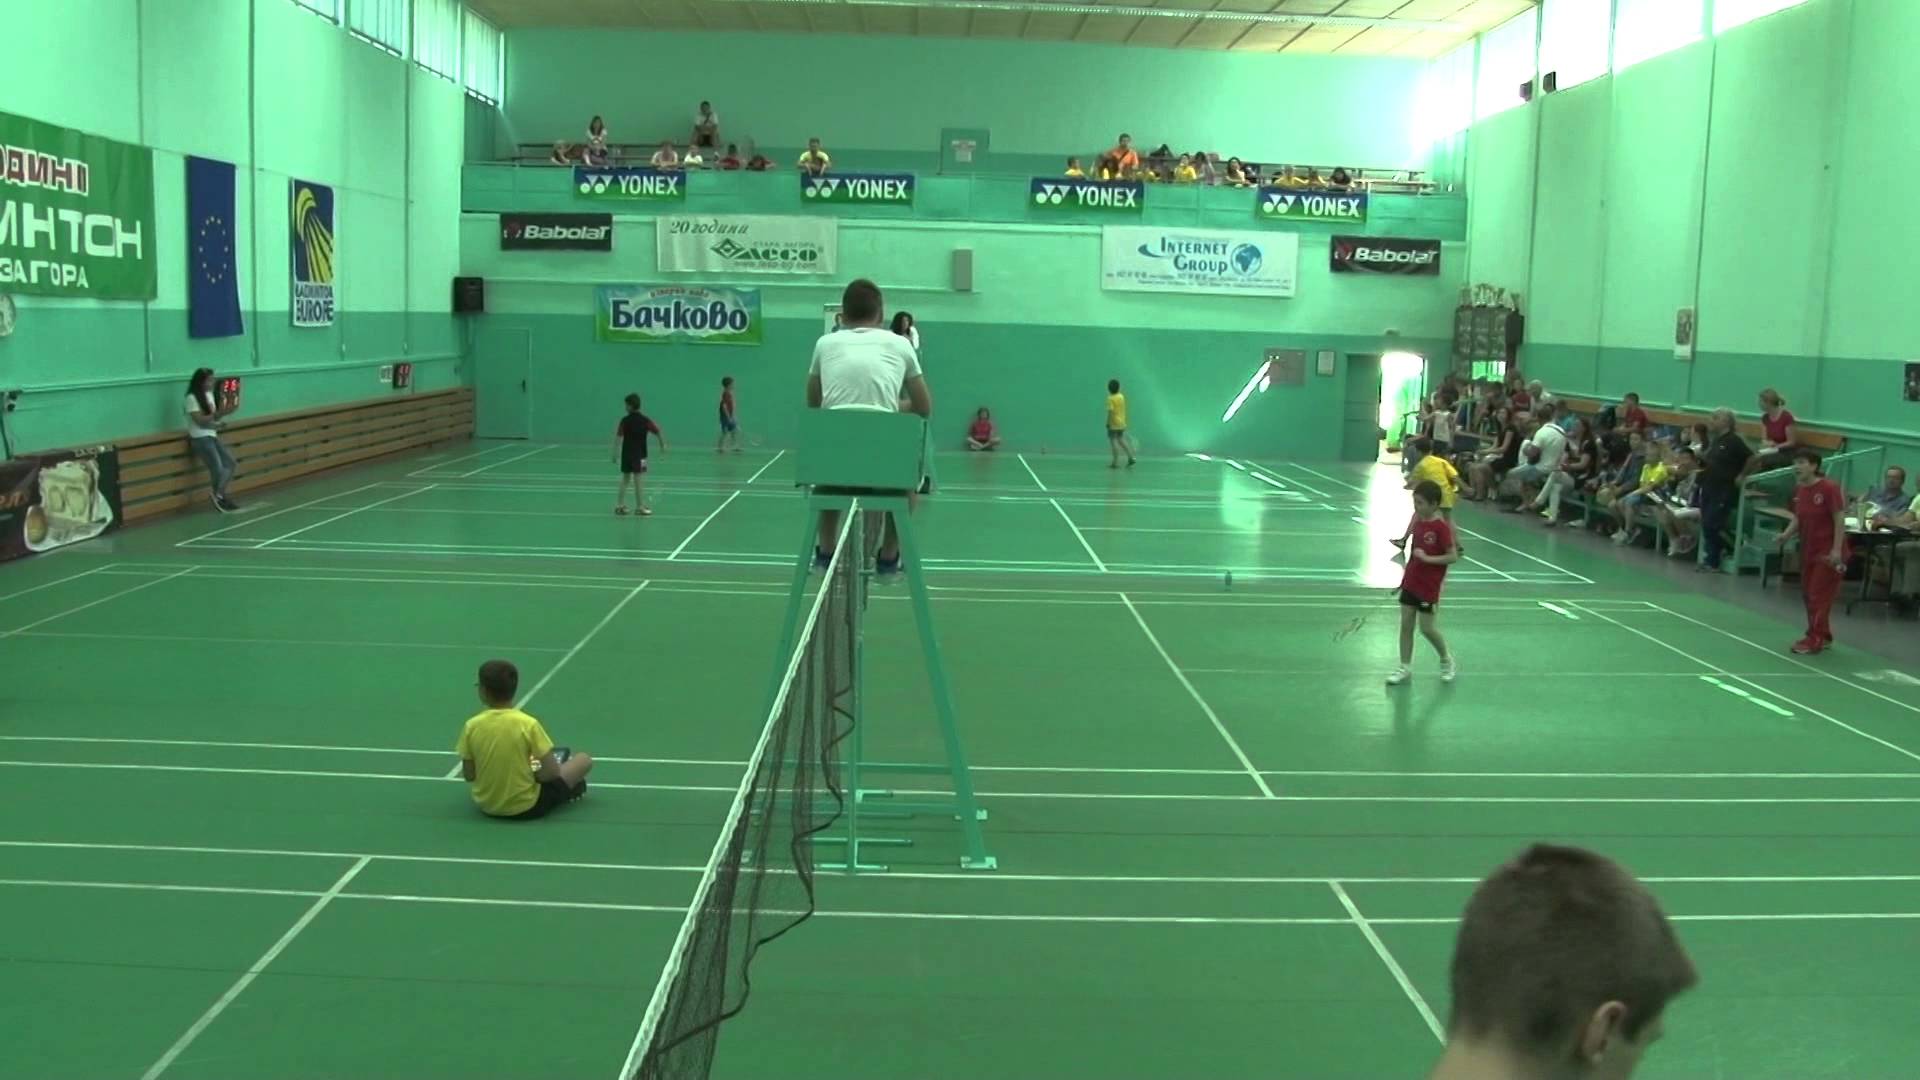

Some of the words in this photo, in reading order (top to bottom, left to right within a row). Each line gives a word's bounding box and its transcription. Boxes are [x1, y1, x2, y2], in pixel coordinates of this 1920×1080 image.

[618, 175, 679, 195] YONEX
[845, 179, 907, 199] YONEX
[1075, 185, 1137, 207] YONEX
[1301, 195, 1361, 217] YONEX
[670, 220, 690, 234] 20
[1161, 236, 1229, 256] INTERNET
[0, 258, 88, 288] ЗАГОРА
[1173, 254, 1229, 275] GROUP
[611, 299, 749, 331] Бачково
